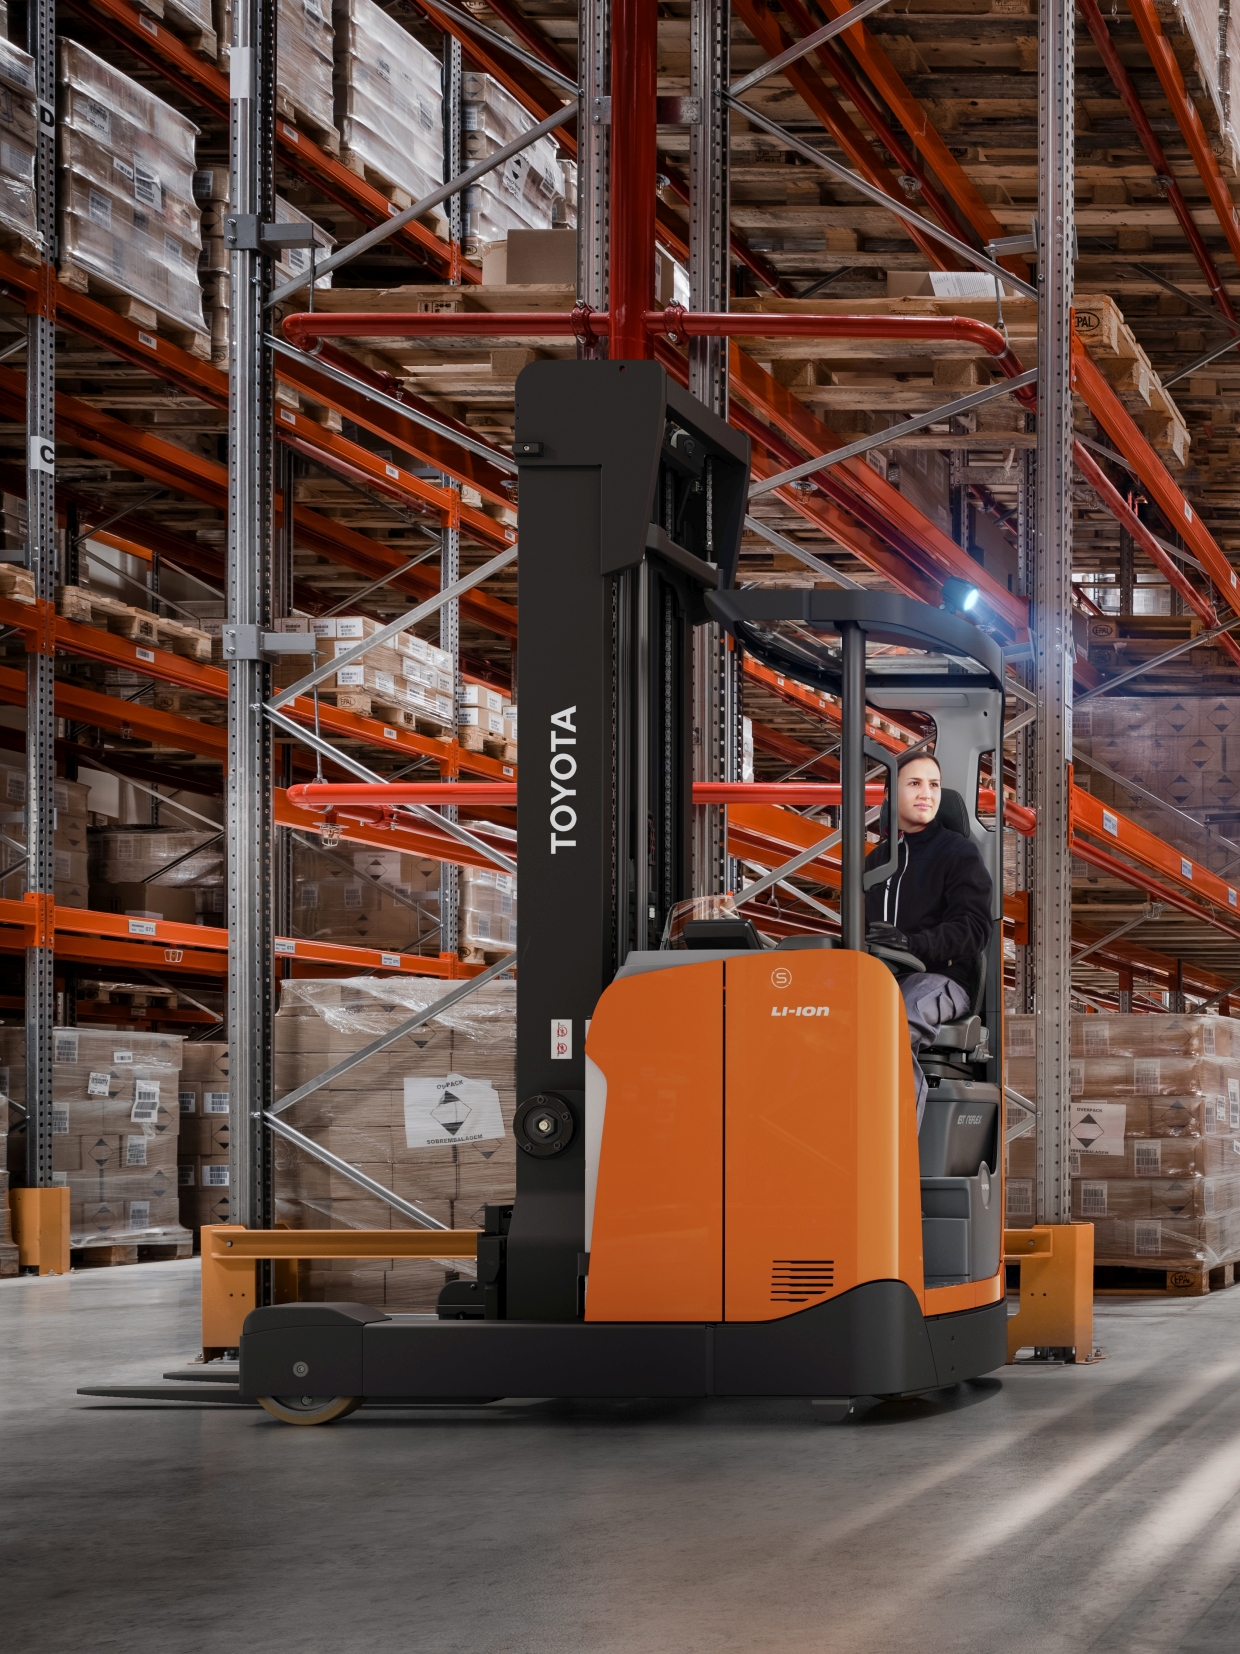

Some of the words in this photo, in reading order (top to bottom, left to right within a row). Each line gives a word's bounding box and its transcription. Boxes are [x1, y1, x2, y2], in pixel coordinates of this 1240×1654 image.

[40, 108, 55, 128] D
[40, 445, 55, 464] C
[550, 705, 577, 854] TOYOTA
